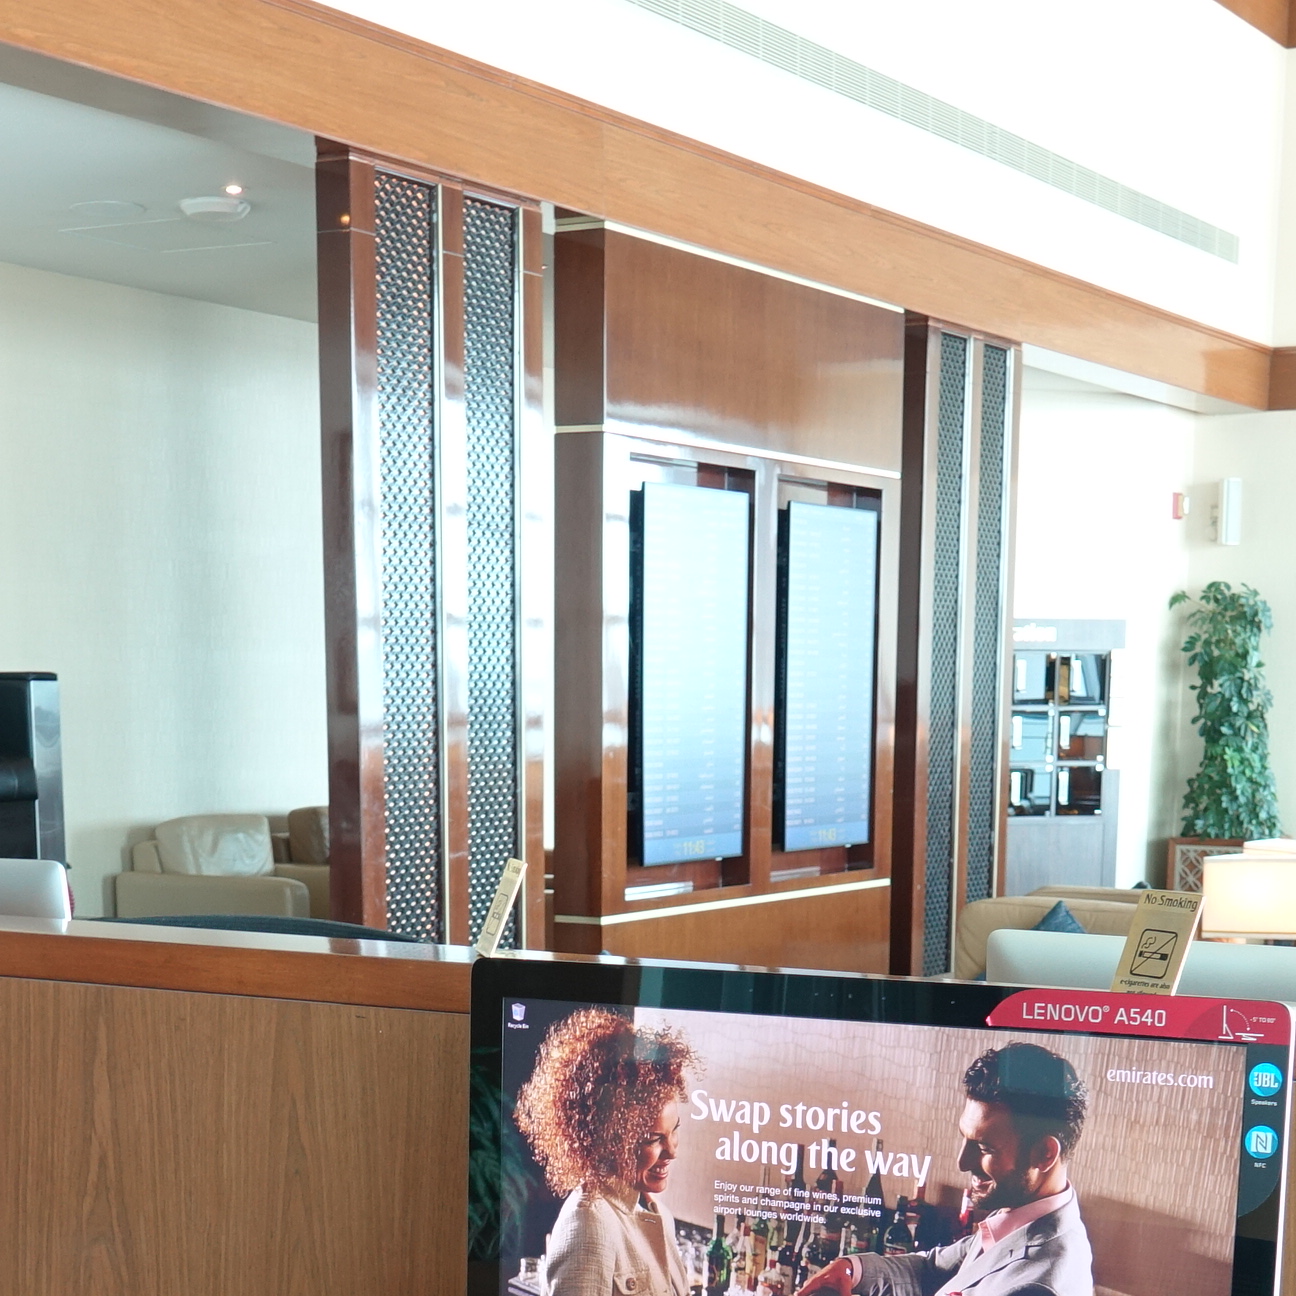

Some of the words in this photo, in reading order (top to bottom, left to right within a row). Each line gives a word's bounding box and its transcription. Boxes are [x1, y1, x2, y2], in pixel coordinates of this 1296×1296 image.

[1144, 893, 1157, 905] No
[1158, 895, 1198, 912] Smoking
[1114, 1008, 1166, 1027] A540
[1106, 1066, 1214, 1089] emirates.com
[690, 1089, 771, 1134] Swap
[779, 1101, 882, 1136] stories
[1250, 1098, 1278, 1107] Speakers
[715, 1131, 798, 1175] along
[808, 1138, 856, 1172] the
[865, 1149, 932, 1188] way
[714, 1180, 737, 1194] Enjoy
[740, 1184, 754, 1193] our
[756, 1186, 781, 1198] range
[783, 1187, 792, 1196] of
[793, 1188, 810, 1199] fine
[812, 1191, 840, 1202] wines,
[842, 1194, 882, 1206] premium
[713, 1205, 741, 1217] airport
[744, 1208, 777, 1220] lounges
[779, 1211, 827, 1225] worldwide.
[714, 1193, 740, 1204] spirits
[742, 1195, 758, 1205] and
[760, 1197, 811, 1211] champagne
[813, 1201, 821, 1211] in
[823, 1205, 838, 1214] our
[840, 1206, 881, 1218] exclusive
